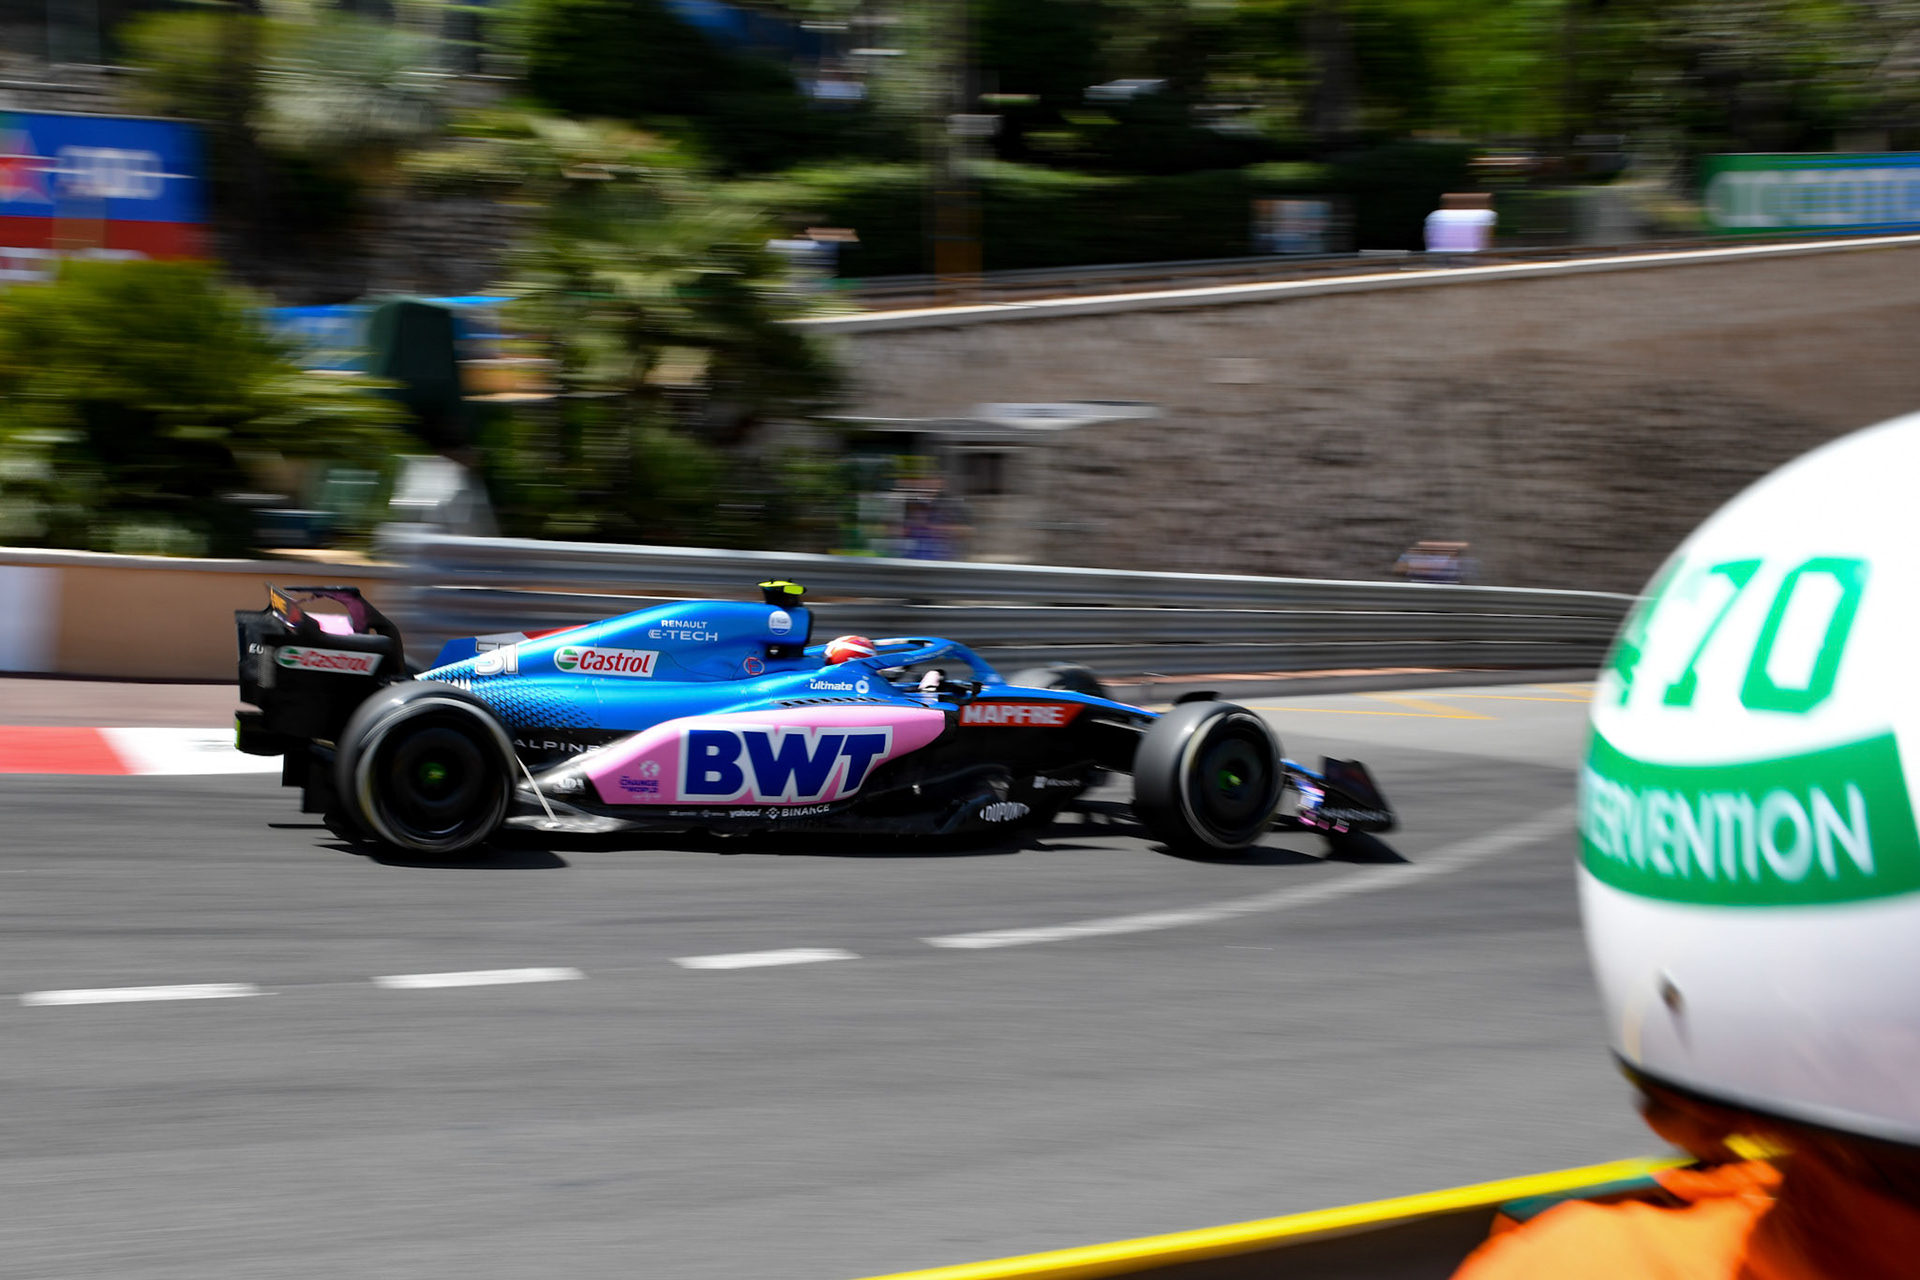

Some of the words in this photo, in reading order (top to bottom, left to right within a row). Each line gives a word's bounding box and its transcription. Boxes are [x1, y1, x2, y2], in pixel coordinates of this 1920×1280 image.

[661, 619, 708, 629] RENAULT
[648, 629, 719, 642] E-TECH
[475, 642, 518, 675] 51
[579, 650, 651, 673] Castrol
[810, 681, 853, 690] ultimate
[962, 705, 1066, 725] MAPFRE
[684, 729, 887, 797] BWT
[781, 804, 831, 817] BINANCE
